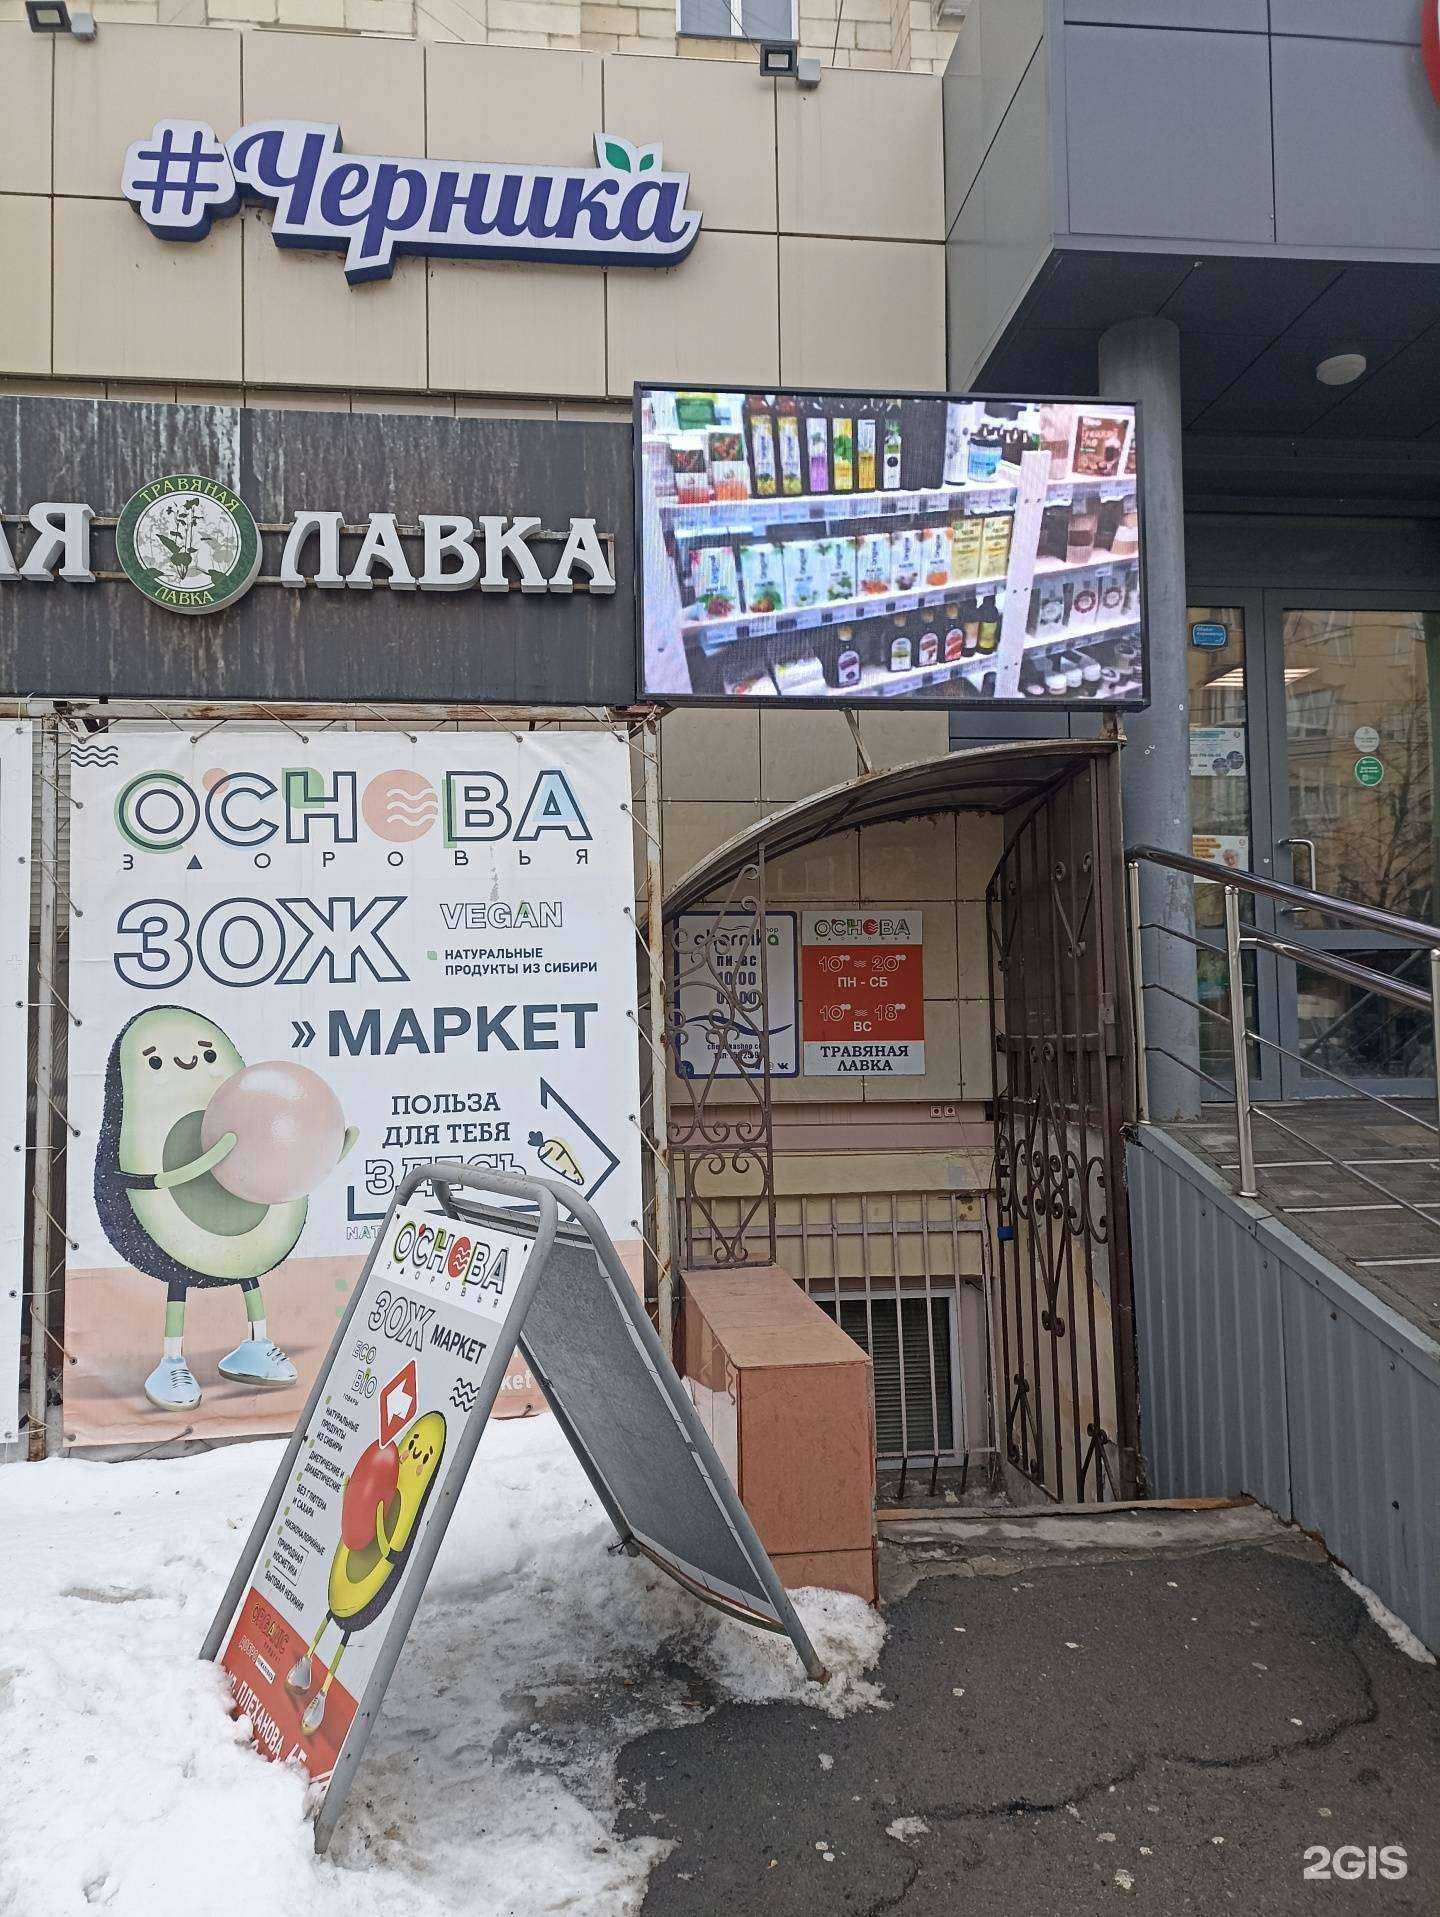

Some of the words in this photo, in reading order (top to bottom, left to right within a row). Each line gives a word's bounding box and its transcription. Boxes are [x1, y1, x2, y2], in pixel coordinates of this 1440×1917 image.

[137, 128, 692, 259] #Черника
[140, 478, 240, 512] ТРАВЯНАЯ
[0, 502, 96, 583] Я
[280, 510, 617, 594] ЛАВКА
[154, 586, 215, 606] ЛАВКА
[113, 767, 594, 854] ОСНОВА
[440, 901, 563, 930] VEGAN
[815, 918, 911, 937] ОСНОВА
[113, 896, 410, 989] ЗОЖ
[444, 947, 543, 961] НАТУРАЛЬНЫЕ
[445, 962, 519, 976] ПРОДУКТЫ
[522, 962, 541, 974] ИЗ
[544, 961, 598, 973] СИБИРИ
[838, 977, 856, 987] ПН
[870, 976, 888, 987] СБ
[853, 1021, 872, 1032] ВС
[820, 1045, 909, 1057] ТРАВЯНАЯ
[837, 1060, 893, 1071] ЛАВКА
[392, 1092, 500, 1115] ПОЛЬЗА
[382, 1125, 440, 1148] ДЛЯ
[447, 1122, 511, 1143] ТЕБЯ
[393, 1221, 509, 1294] ОСНОВА
[368, 1290, 434, 1352] ЗОЖ
[430, 1324, 487, 1365] МАРКЕТ
[352, 1340, 377, 1365] ECO
